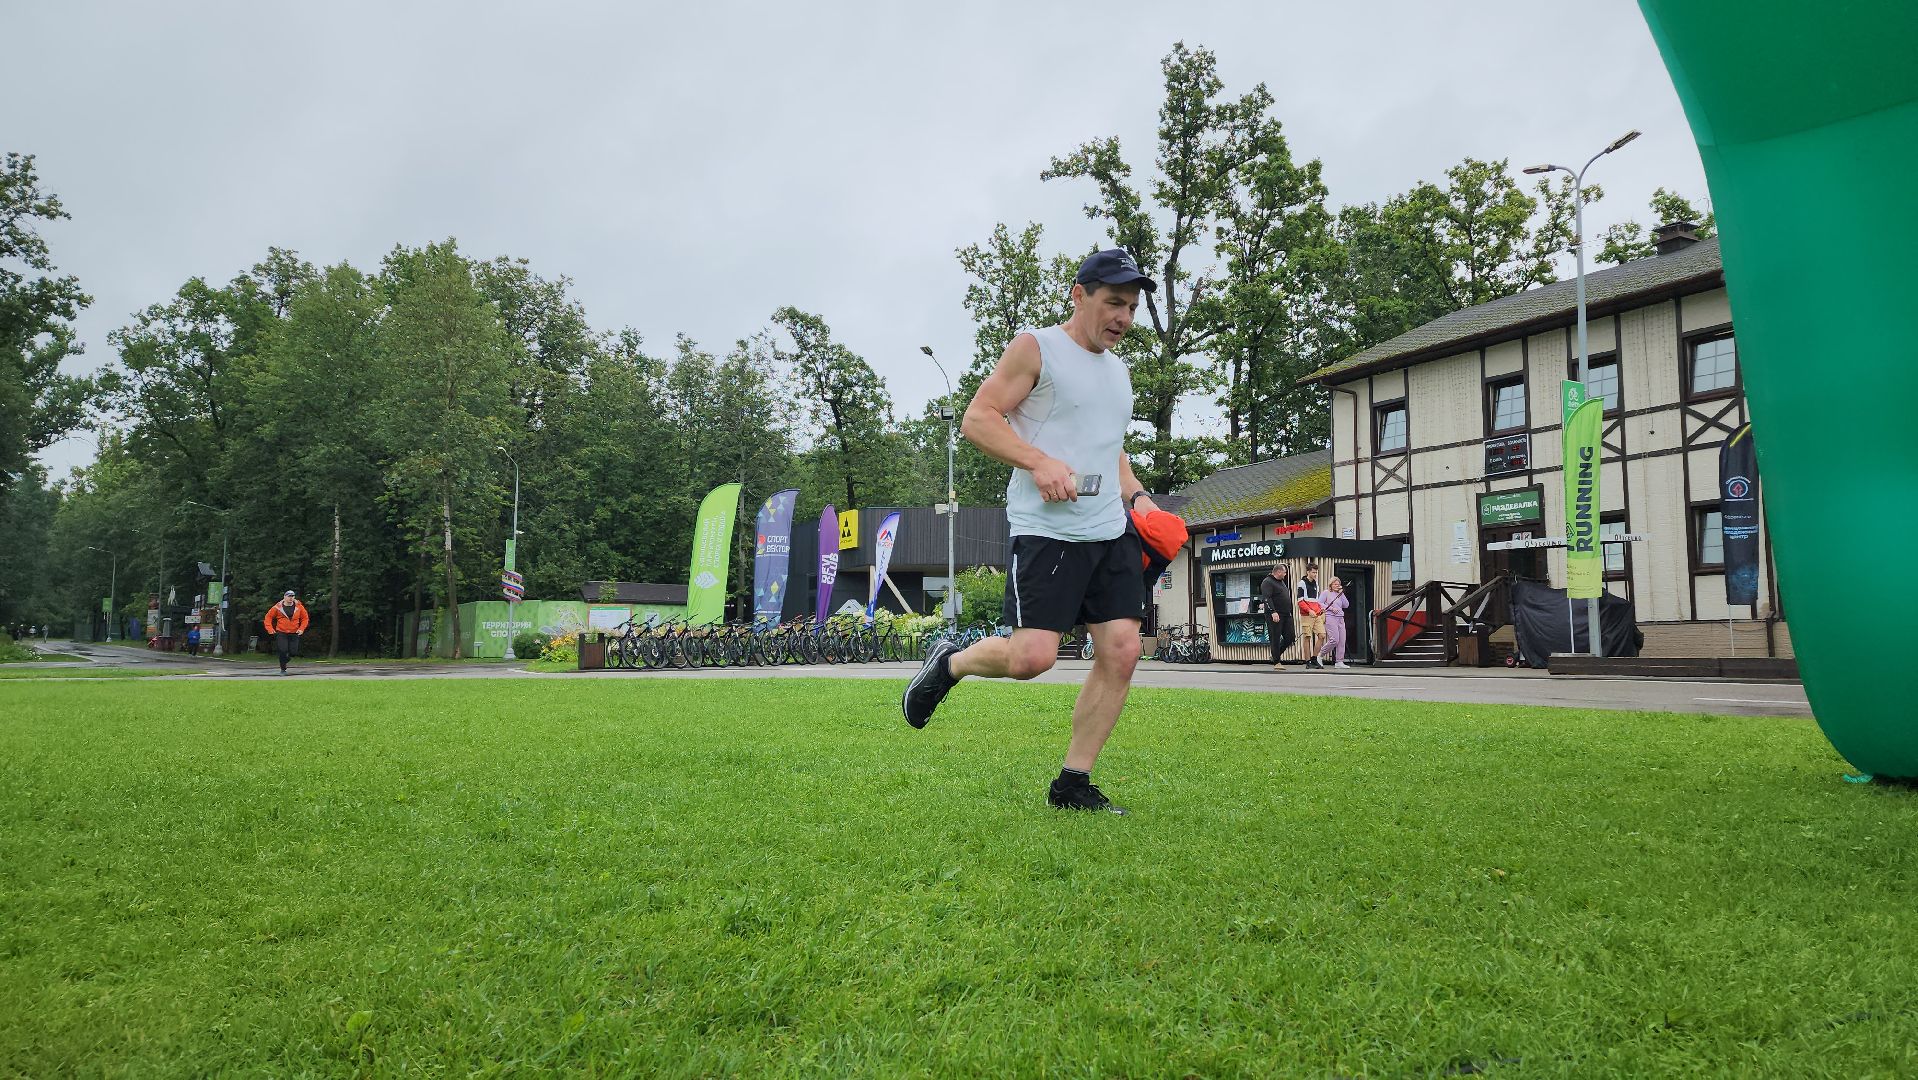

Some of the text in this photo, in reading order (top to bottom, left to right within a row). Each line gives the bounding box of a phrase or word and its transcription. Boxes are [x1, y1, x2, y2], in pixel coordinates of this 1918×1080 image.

[1492, 500, 1538, 512] РАЗДЕВАЛКА
[1576, 446, 1593, 552] RUNNING
[767, 535, 788, 543] СПОРТ
[1212, 544, 1270, 561] MAKE coffee
[826, 553, 839, 584] CLUB
[490, 630, 521, 638] СПОТА
